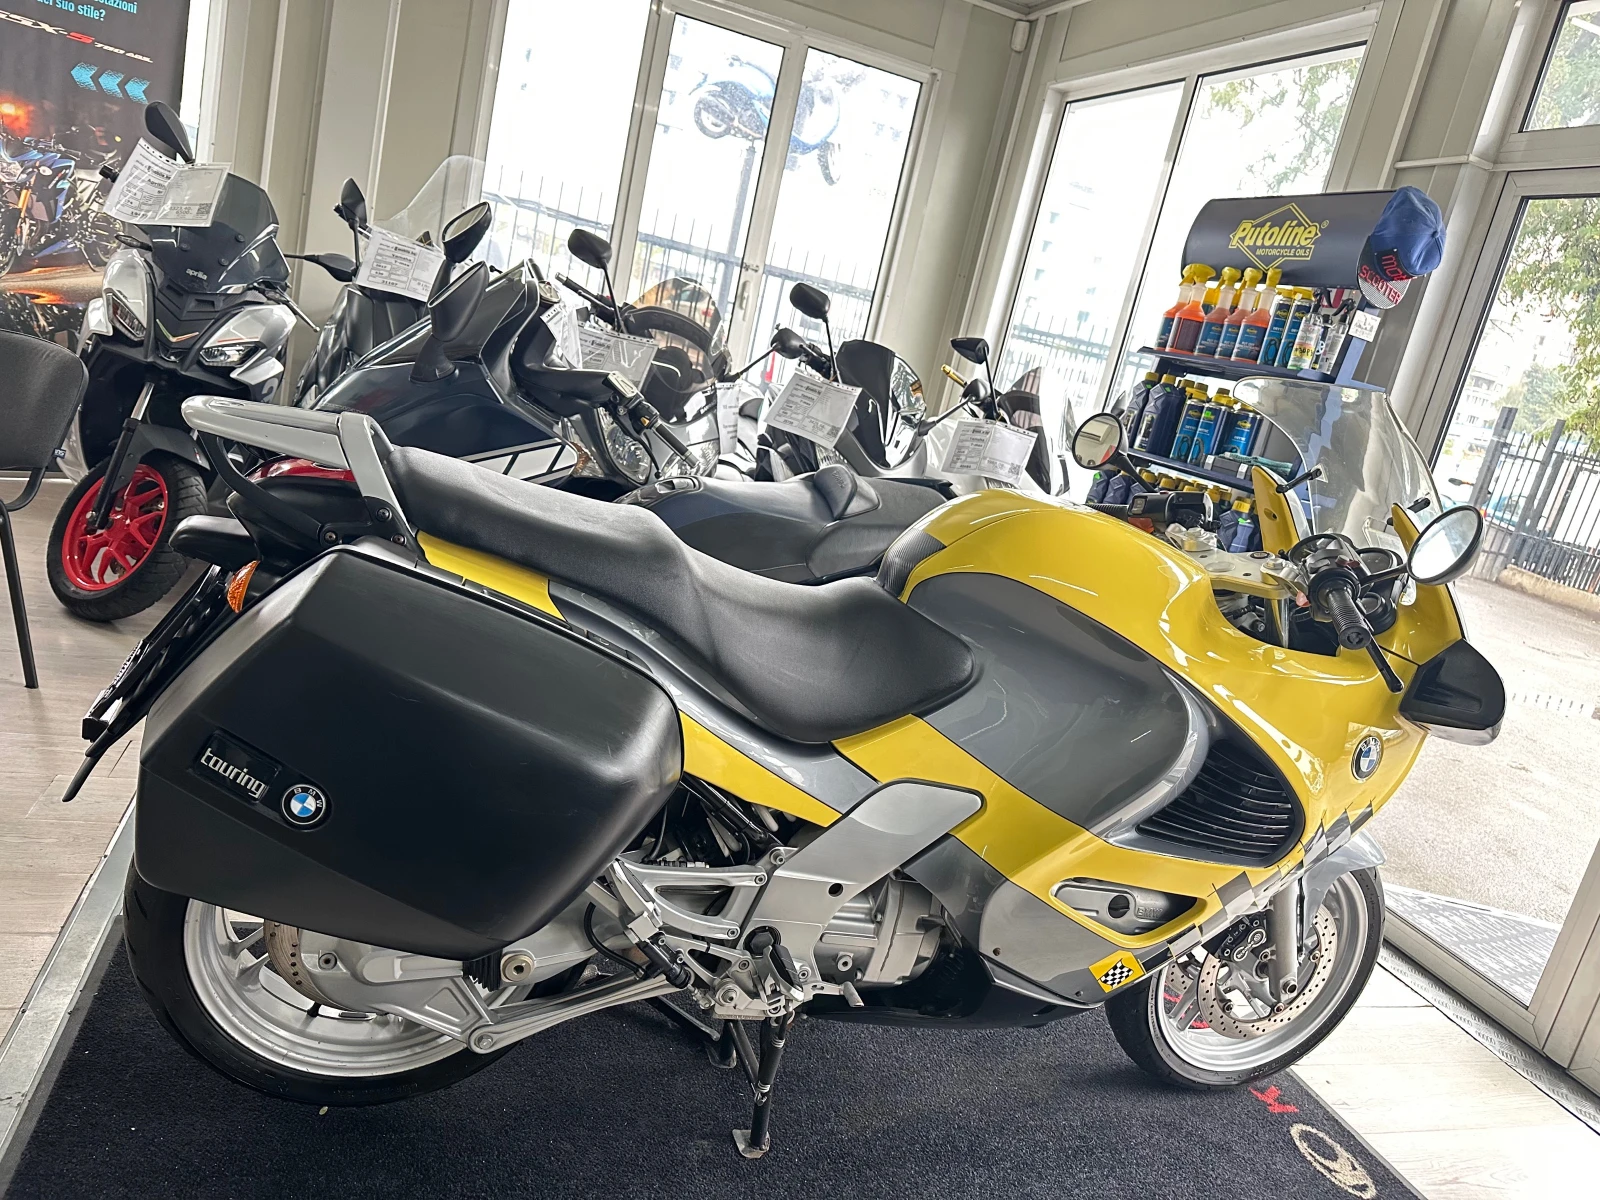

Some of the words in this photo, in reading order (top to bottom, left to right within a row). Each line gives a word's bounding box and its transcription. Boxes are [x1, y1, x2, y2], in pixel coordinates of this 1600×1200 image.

[55, 0, 75, 12] suo
[78, 4, 106, 21] stile?
[1231, 220, 1316, 247] Putoline
[1256, 248, 1295, 256] MOTORCYCLE
[1295, 248, 1310, 256] OILS
[185, 268, 208, 280] aprilia
[1358, 264, 1403, 305] SCOOTER
[200, 747, 267, 799] touring
[1137, 906, 1164, 919] BMW
